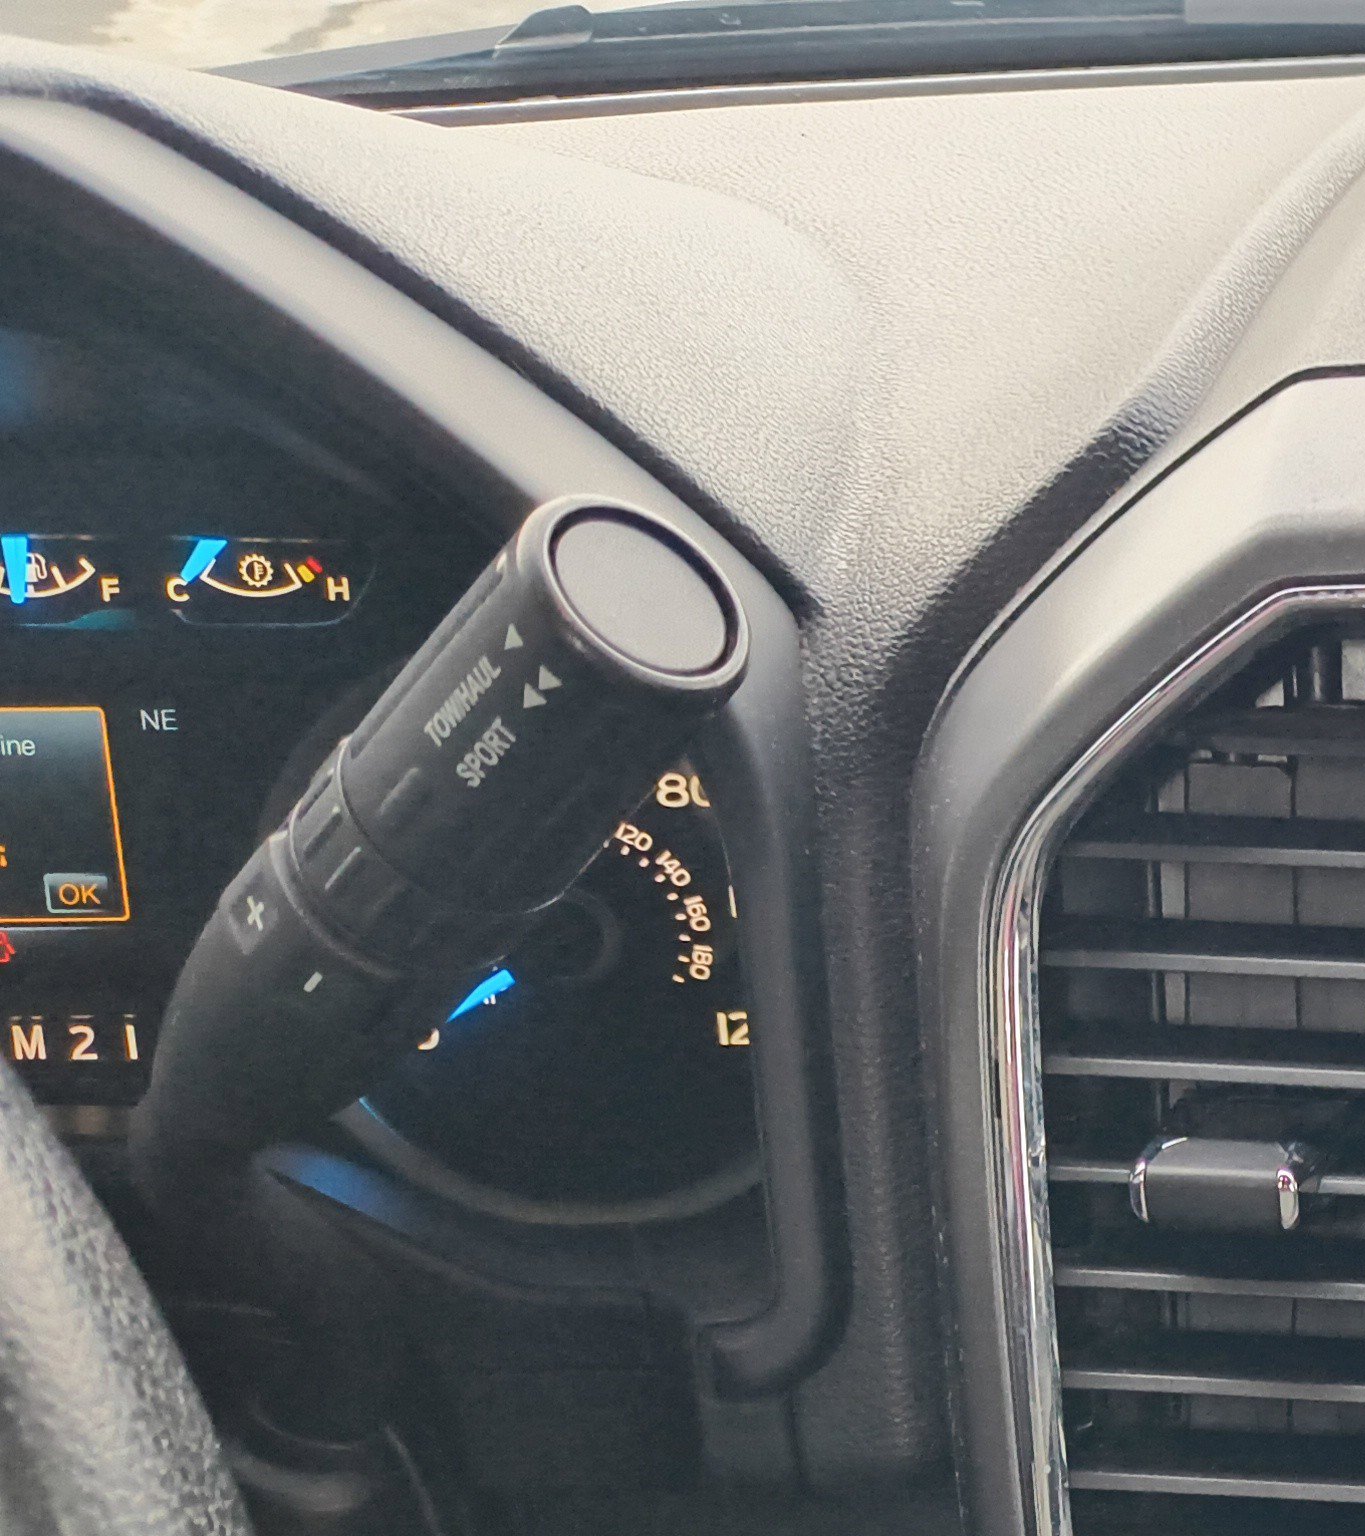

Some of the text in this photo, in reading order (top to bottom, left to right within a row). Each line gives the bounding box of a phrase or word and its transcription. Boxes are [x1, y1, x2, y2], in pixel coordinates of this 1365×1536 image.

[101, 577, 120, 602] F
[166, 577, 350, 602] C H
[140, 708, 178, 731] NE
[455, 718, 519, 788] SPORT
[614, 822, 653, 852] 120
[655, 849, 691, 887] 140
[58, 884, 101, 905] OK
[683, 895, 711, 932] 160
[689, 944, 714, 980] 180
[11, 1024, 47, 1061] M
[69, 1025, 98, 1061] 2
